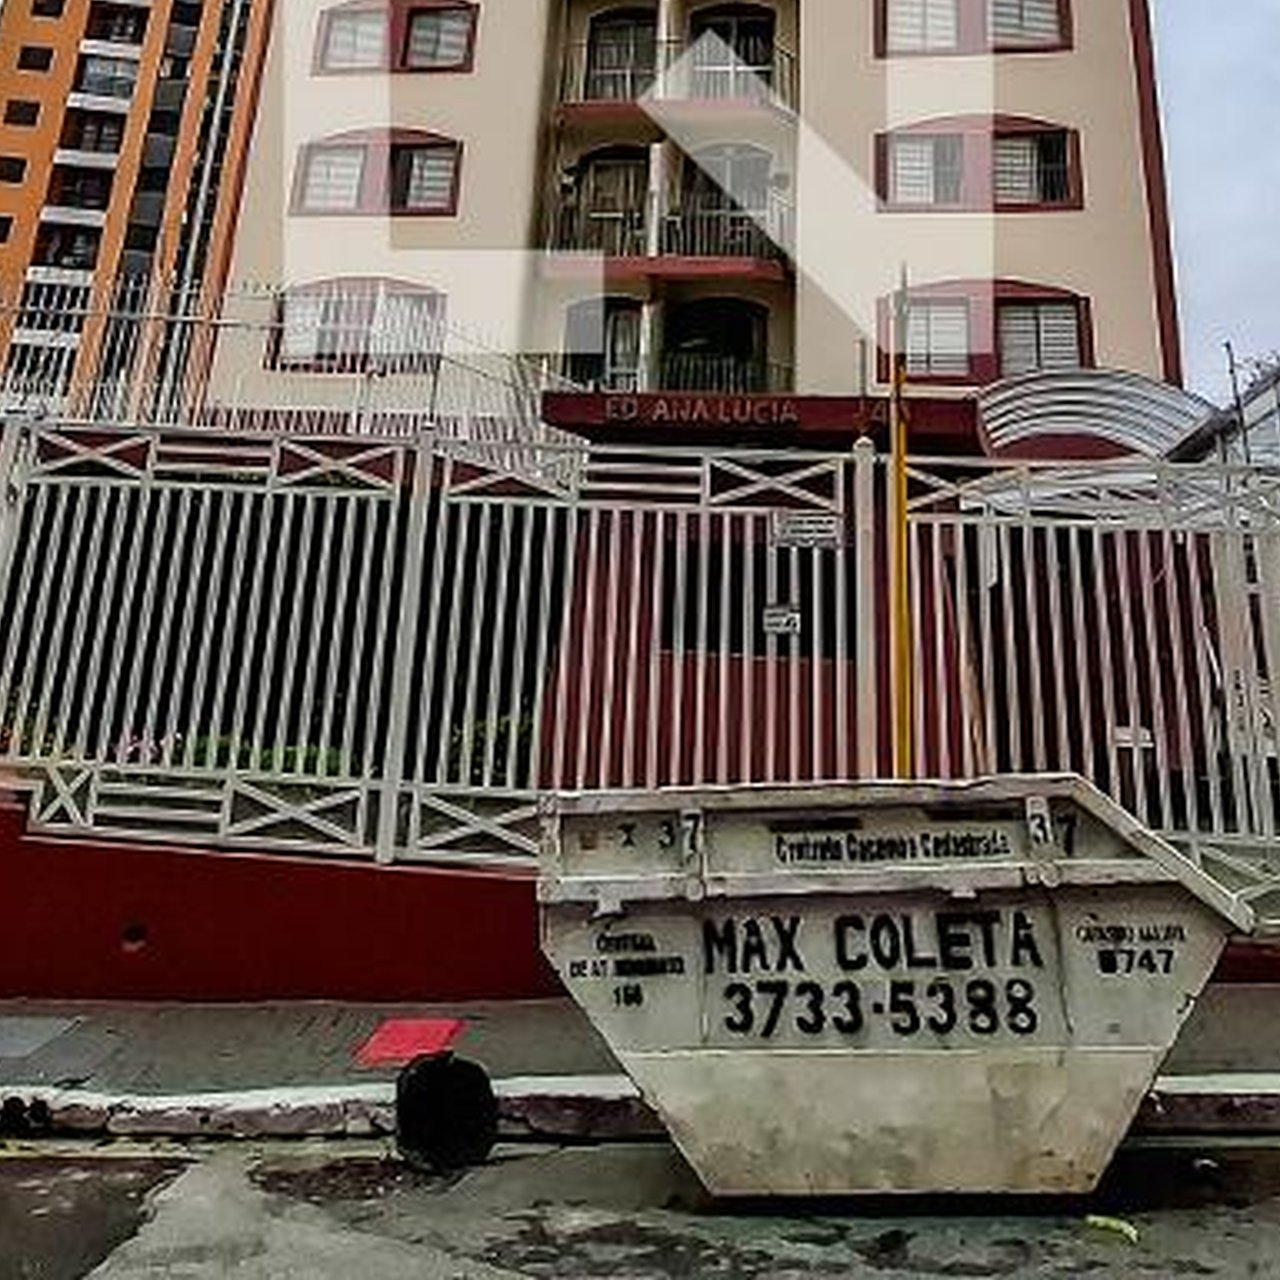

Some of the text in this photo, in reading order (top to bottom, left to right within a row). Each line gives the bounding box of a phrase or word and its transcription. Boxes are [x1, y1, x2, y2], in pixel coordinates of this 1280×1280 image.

[606, 397, 799, 423] ED ANA LUCIA
[701, 910, 1043, 974] MAX COLETA
